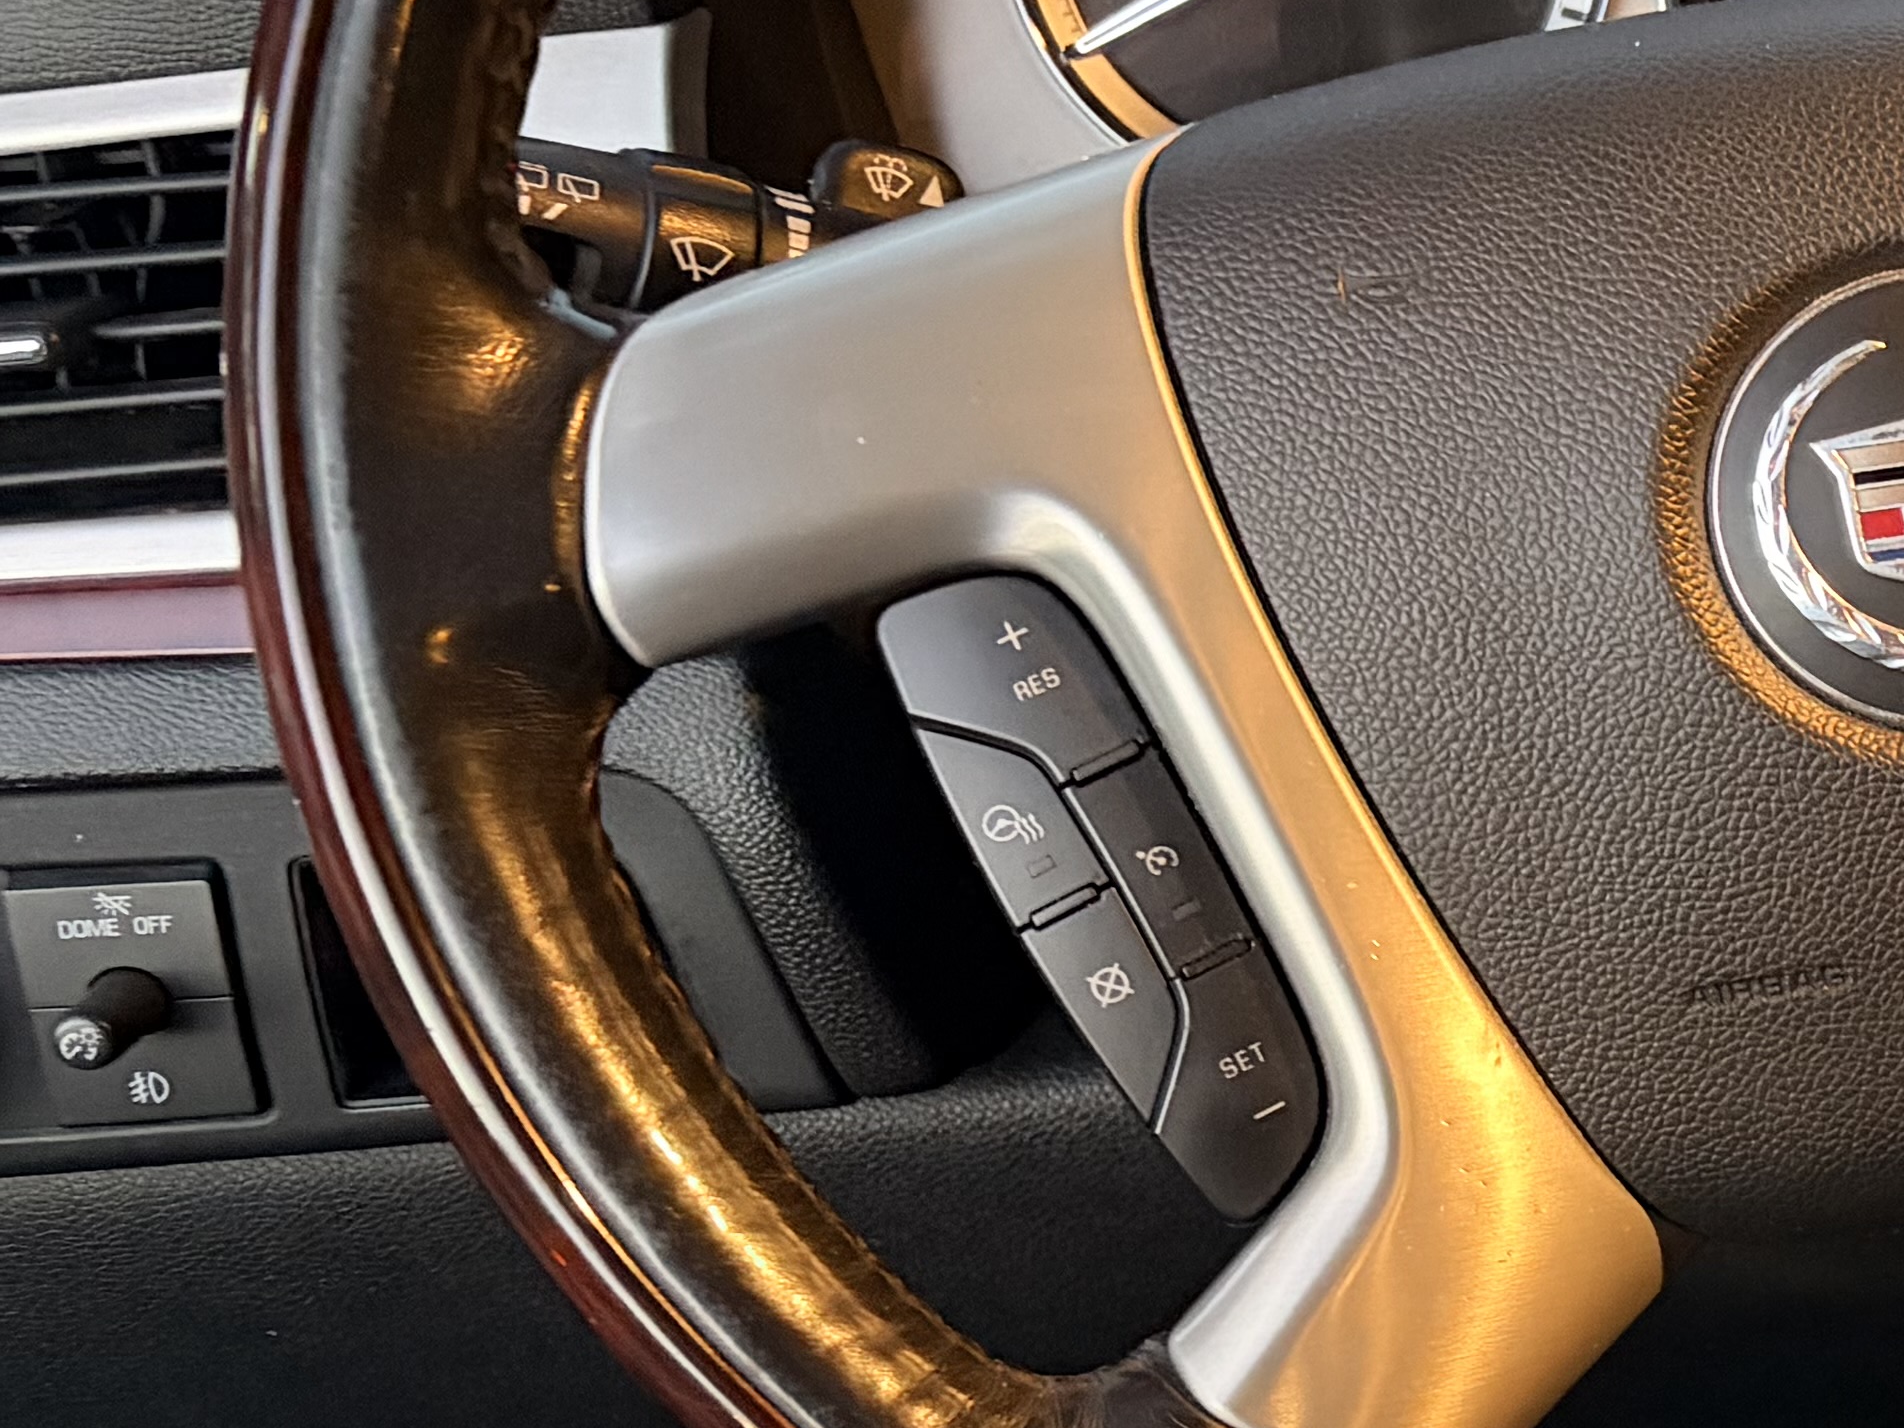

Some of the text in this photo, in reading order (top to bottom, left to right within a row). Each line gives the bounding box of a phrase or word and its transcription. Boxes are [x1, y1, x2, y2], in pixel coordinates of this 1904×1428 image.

[1012, 666, 1062, 702] RES
[56, 914, 174, 941] DOME OFF
[1218, 1042, 1268, 1081] SET
